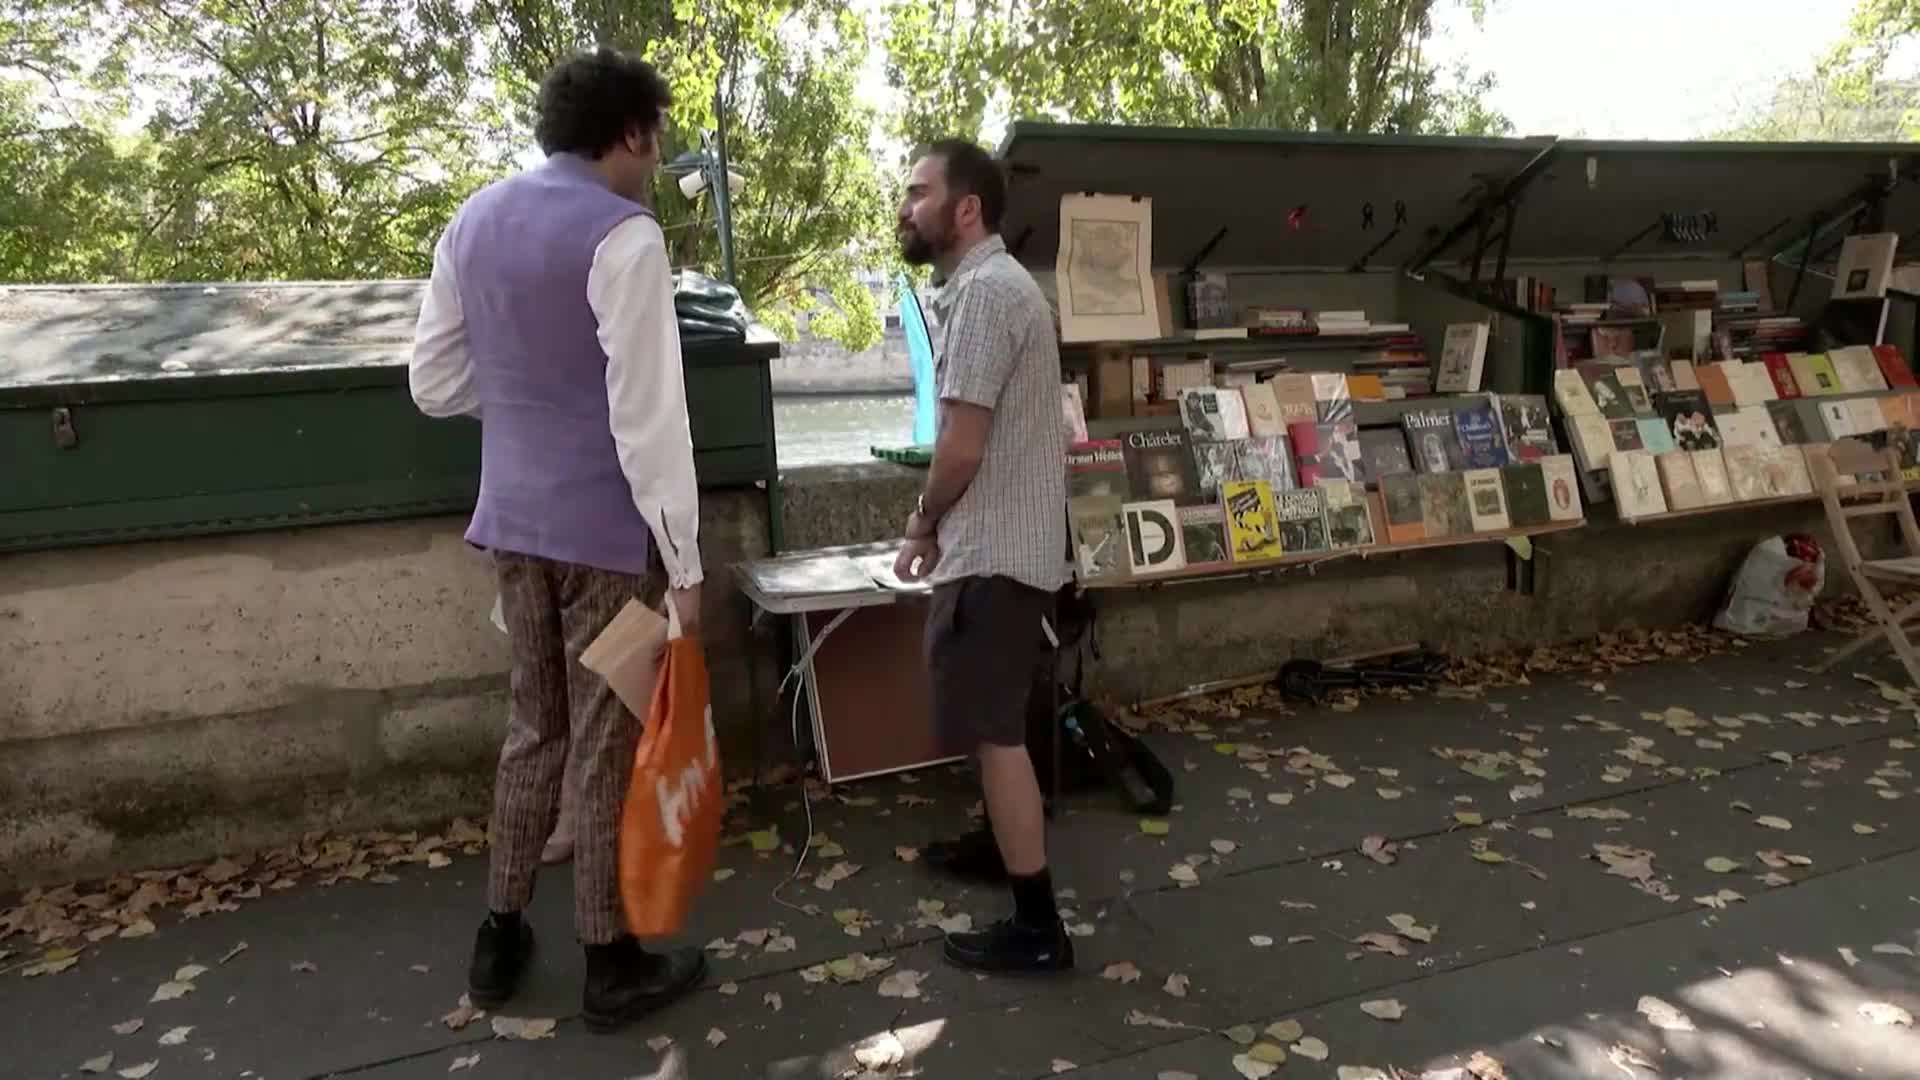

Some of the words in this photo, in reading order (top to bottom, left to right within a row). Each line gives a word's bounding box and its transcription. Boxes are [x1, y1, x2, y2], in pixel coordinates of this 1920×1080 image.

[1404, 411, 1450, 429] Palmer
[1129, 432, 1182, 449] Châtelet
[1126, 510, 1175, 567] D
